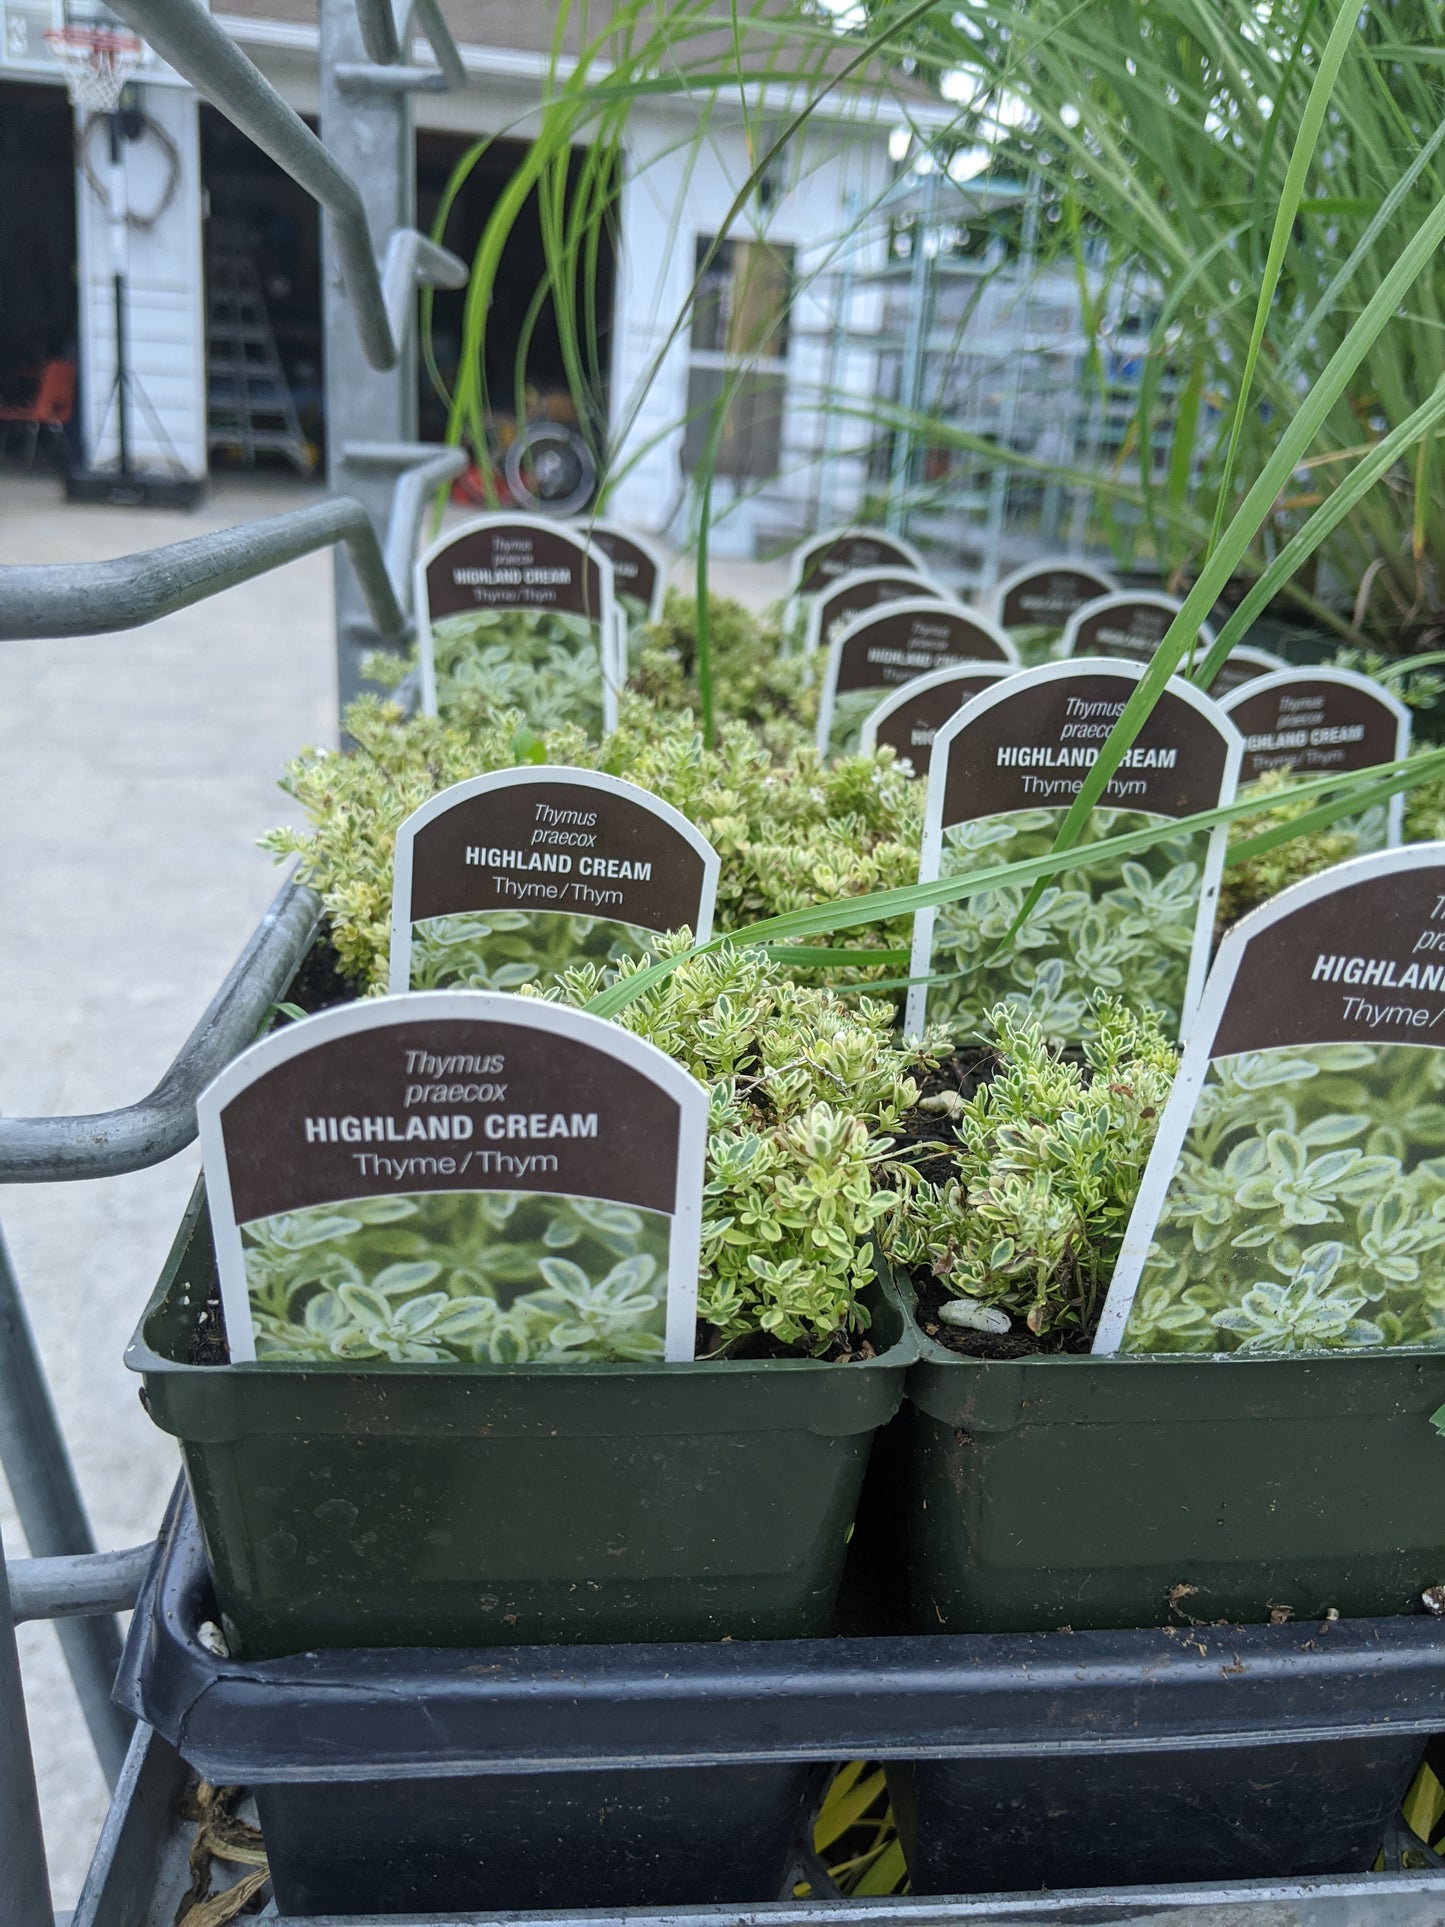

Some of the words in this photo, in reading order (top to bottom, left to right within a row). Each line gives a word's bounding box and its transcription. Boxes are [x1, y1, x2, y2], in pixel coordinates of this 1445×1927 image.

[452, 566, 522, 585] HIGHLAND
[523, 566, 571, 585] CREAM
[1066, 697, 1126, 720] Thymus
[1060, 723, 1115, 742] praeco
[1310, 723, 1366, 746] CREAM
[1118, 748, 1178, 769] REAM
[535, 803, 597, 827] Thymus
[531, 828, 598, 848] praecox
[465, 846, 572, 874] HIGHLAND
[579, 857, 652, 881] CREAM
[492, 876, 624, 906] Thyme/Thym
[1311, 954, 1445, 992] HIGHLAN
[403, 1050, 505, 1079] Thymus
[403, 1082, 509, 1108] praecox
[305, 1115, 474, 1142] HIGHLAND
[484, 1113, 599, 1140] CREAM
[352, 1150, 559, 1180] Thyme/Thym
